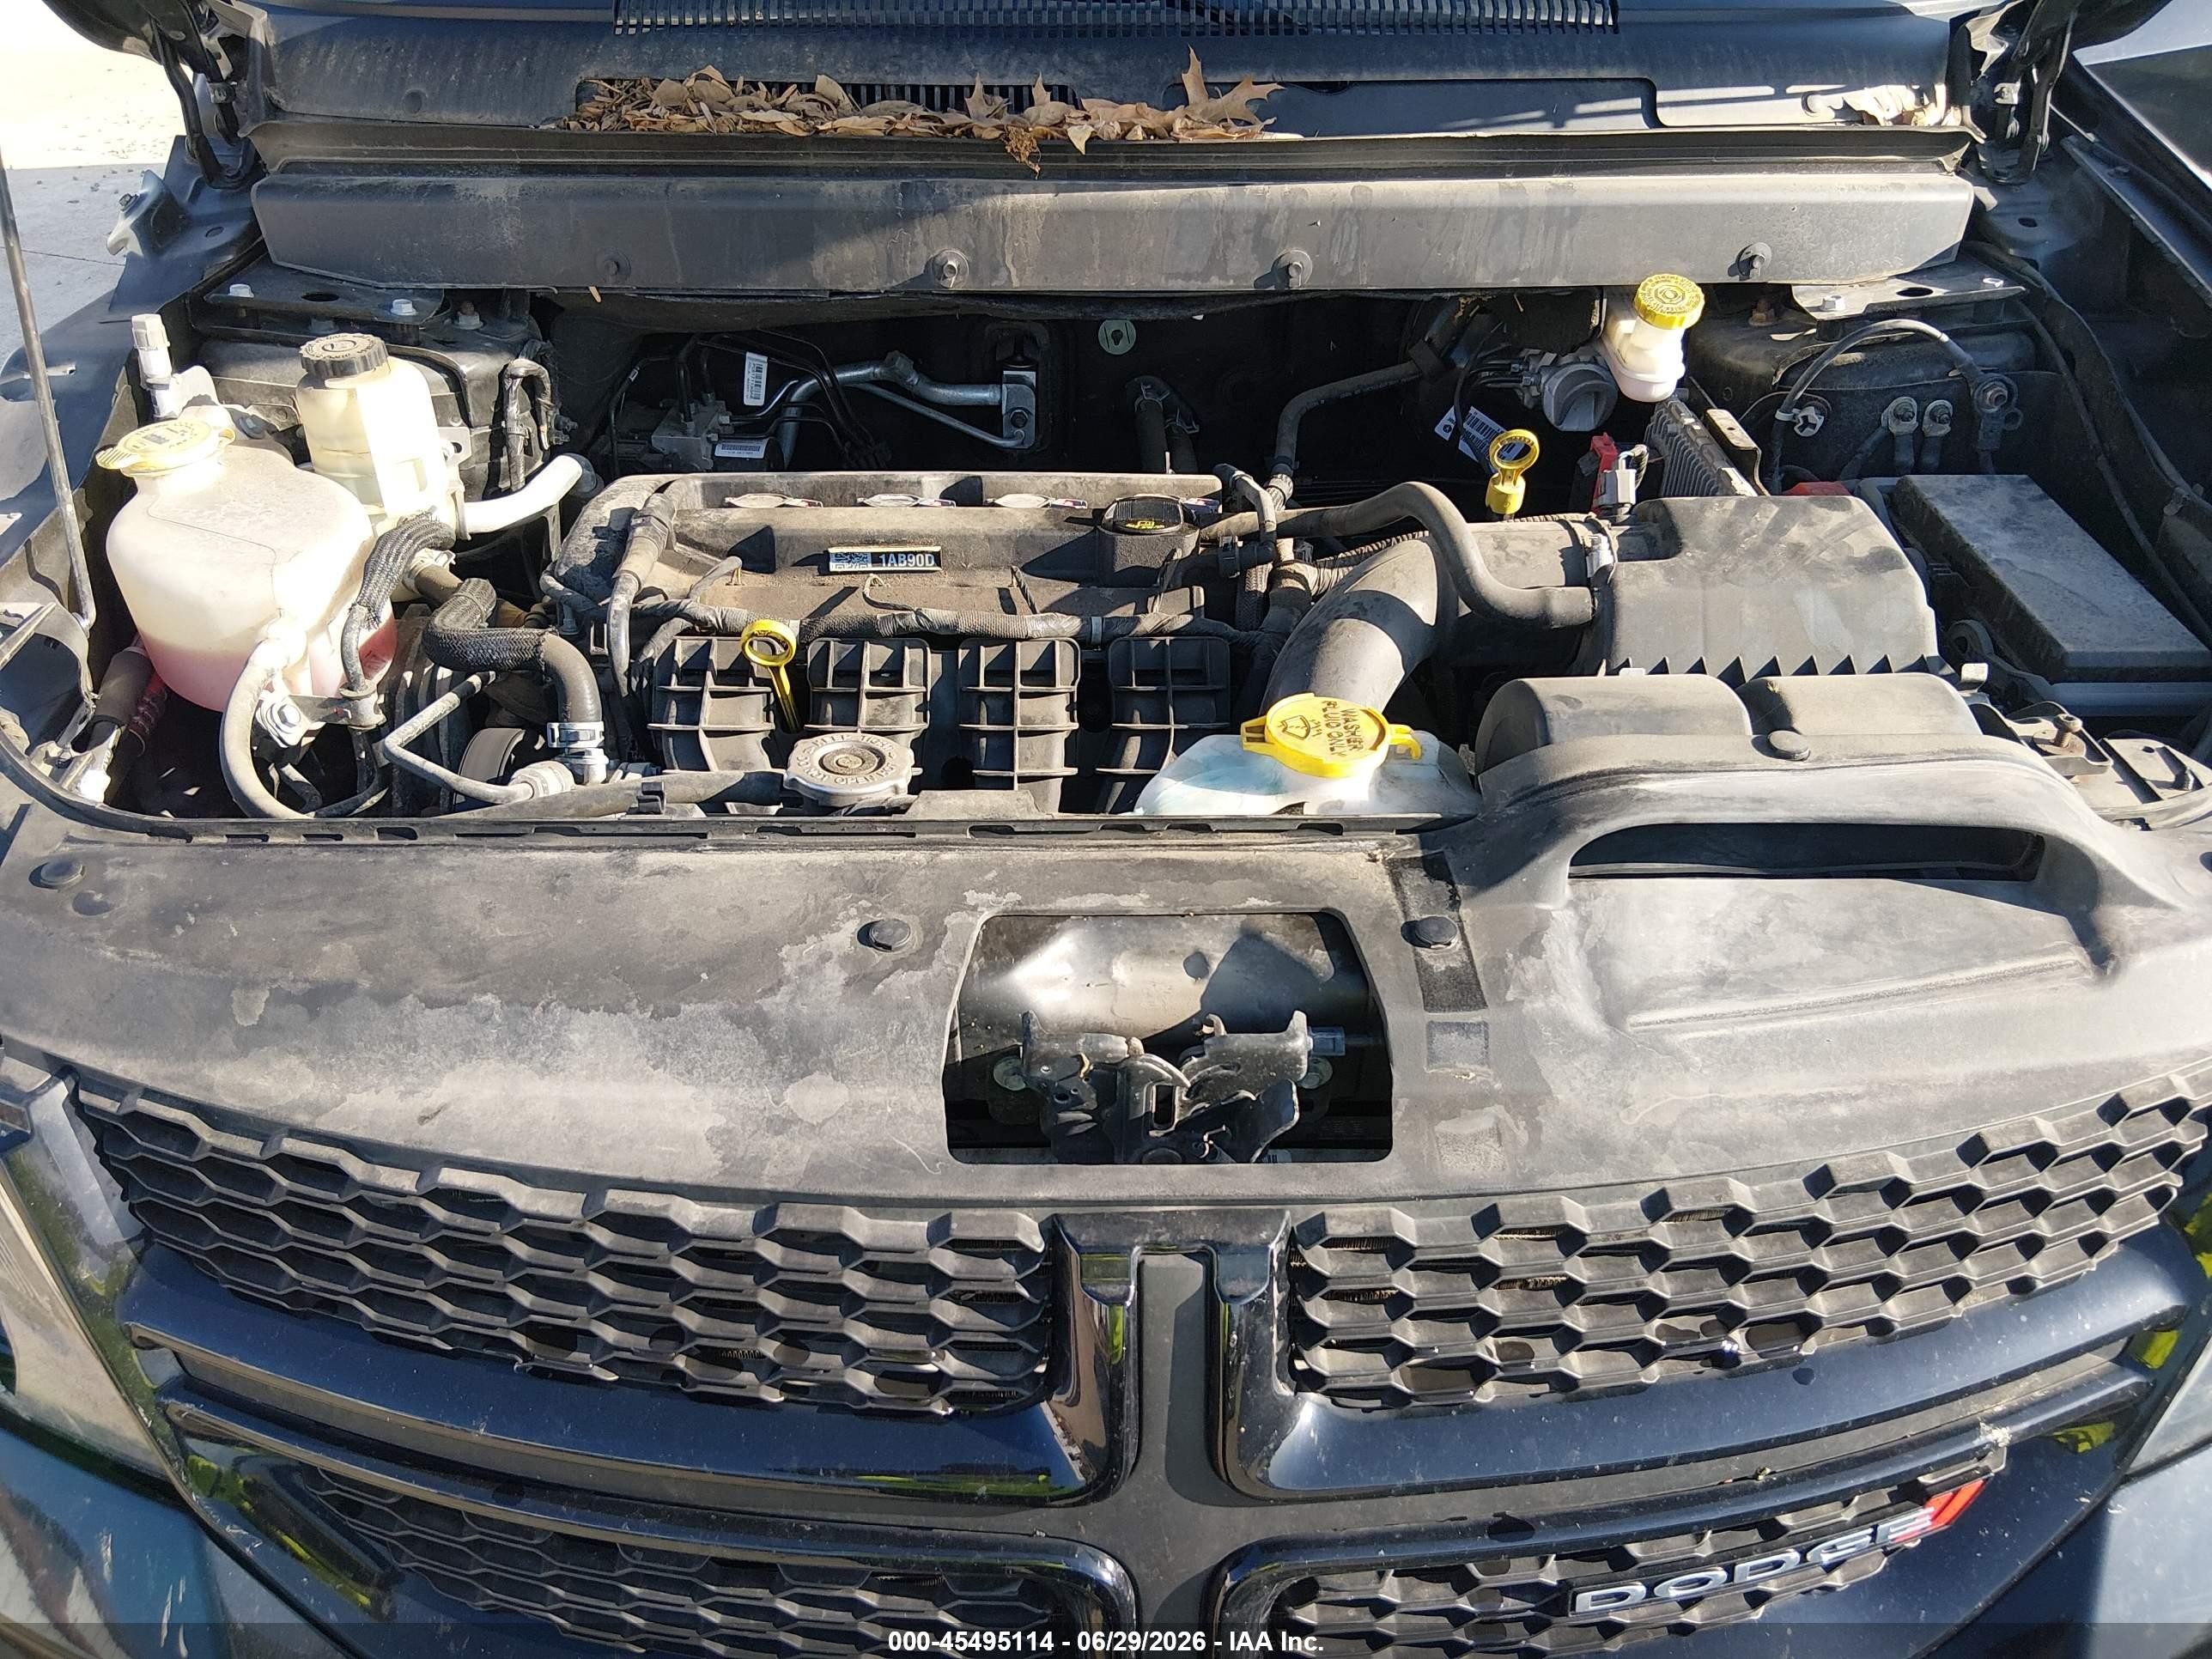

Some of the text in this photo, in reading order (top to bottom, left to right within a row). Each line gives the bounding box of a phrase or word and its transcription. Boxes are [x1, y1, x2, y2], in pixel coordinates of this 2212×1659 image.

[878, 552, 936, 568] 1AB90D
[1322, 700, 1348, 757] FLUID ONLY
[1340, 708, 1364, 751] WASHER
[834, 775, 876, 785] OPEN
[1574, 1504, 1937, 1614] DODGE
